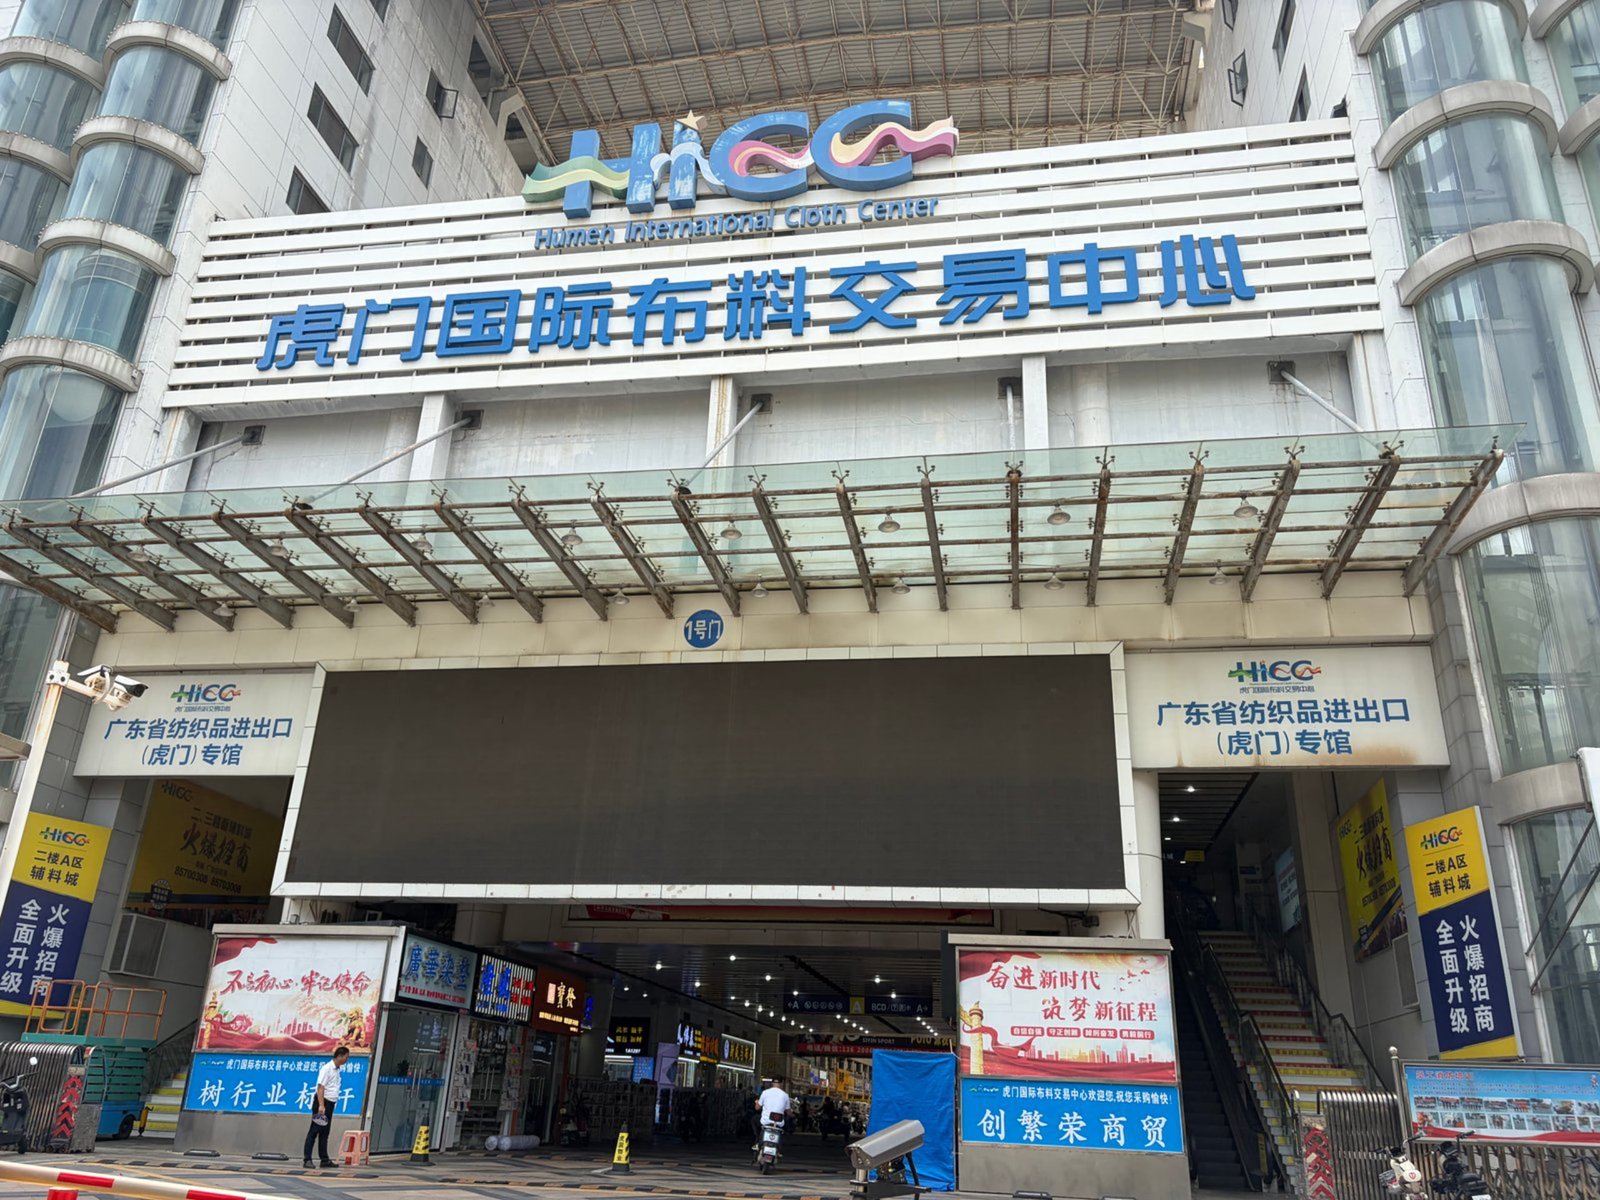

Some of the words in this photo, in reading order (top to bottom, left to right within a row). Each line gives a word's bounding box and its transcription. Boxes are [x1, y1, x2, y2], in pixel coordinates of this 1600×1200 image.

[534, 226, 614, 249] Humen
[624, 208, 774, 241] International
[784, 203, 847, 228] Cloth
[857, 198, 939, 222] Center
[256, 234, 1256, 371] 虎门国际布料交易中心
[685, 619, 721, 640] 1号门
[1157, 698, 1410, 726] 广东省纺织品进出口
[104, 717, 293, 740] 广东省纺织品进出口
[34, 850, 84, 869] 二楼A区
[1425, 854, 1468, 876] 二楼A区
[30, 865, 79, 887] 辅料城
[1428, 873, 1471, 898] 辅料城
[0, 899, 42, 994] 全面升级
[29, 903, 70, 996] 火爆招商
[986, 965, 1101, 990] 奋进新时代
[1436, 919, 1470, 1034] 全面升级
[1459, 914, 1494, 1032] 火爆招商
[1042, 996, 1157, 1022] 筑梦新征程
[976, 1108, 1167, 1148] 创繁荣商贸
